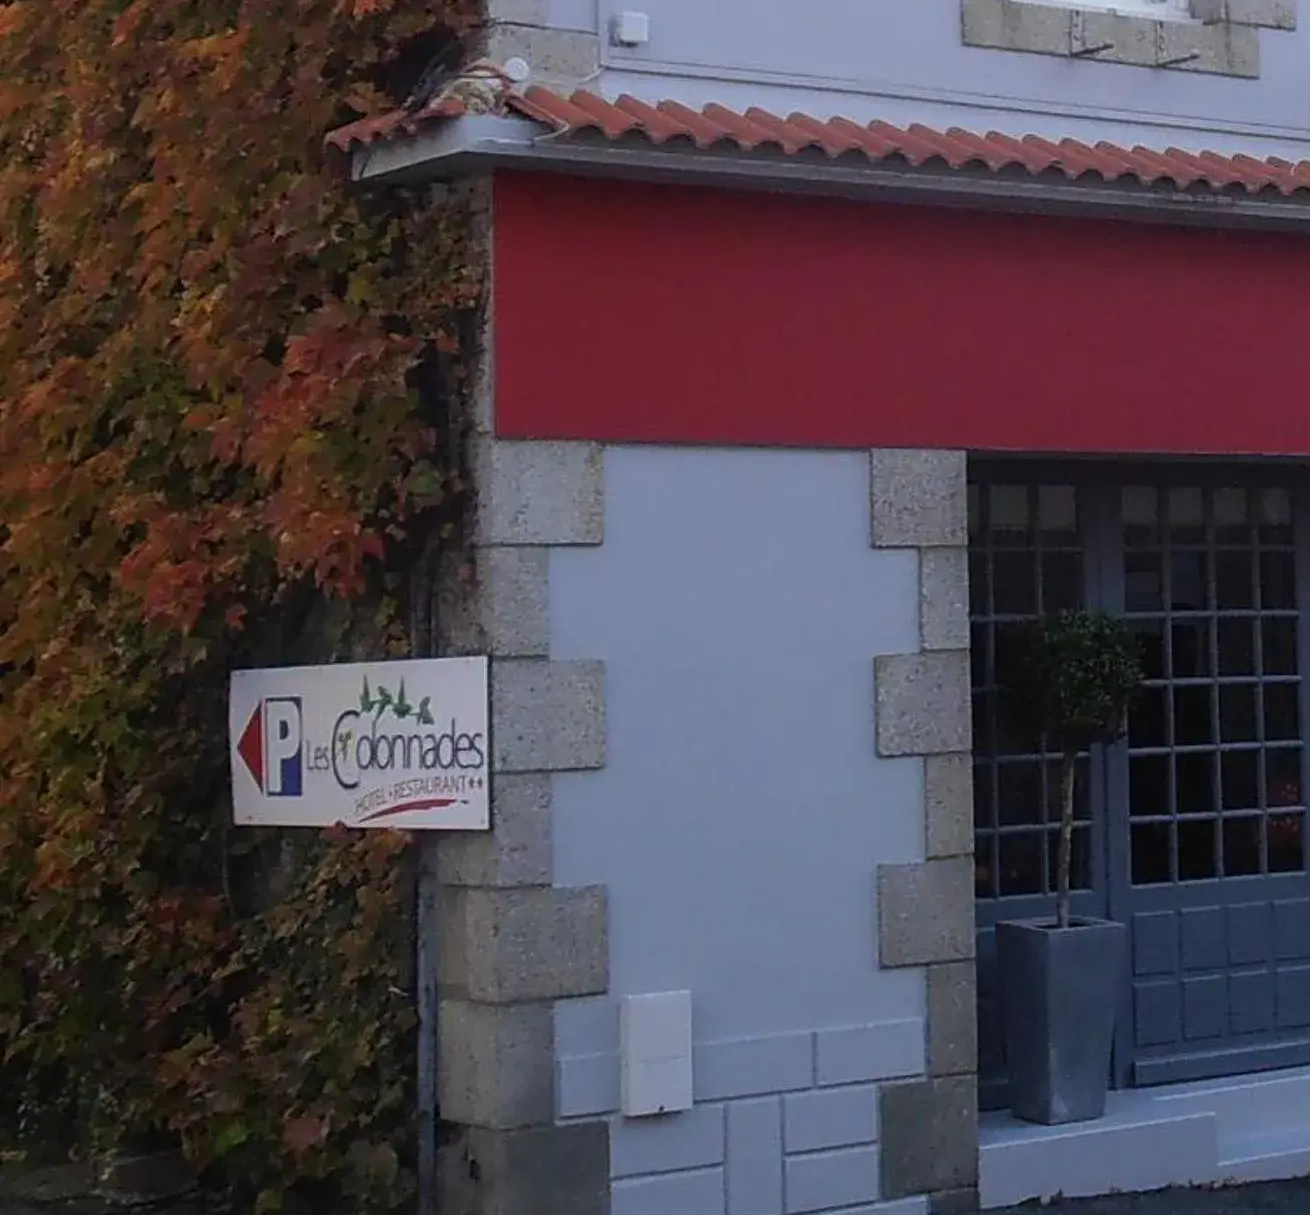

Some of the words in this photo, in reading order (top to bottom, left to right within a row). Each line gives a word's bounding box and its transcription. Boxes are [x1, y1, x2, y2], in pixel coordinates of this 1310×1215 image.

[267, 700, 301, 794] P
[306, 740, 330, 771] Les
[332, 709, 484, 790] Colonnades
